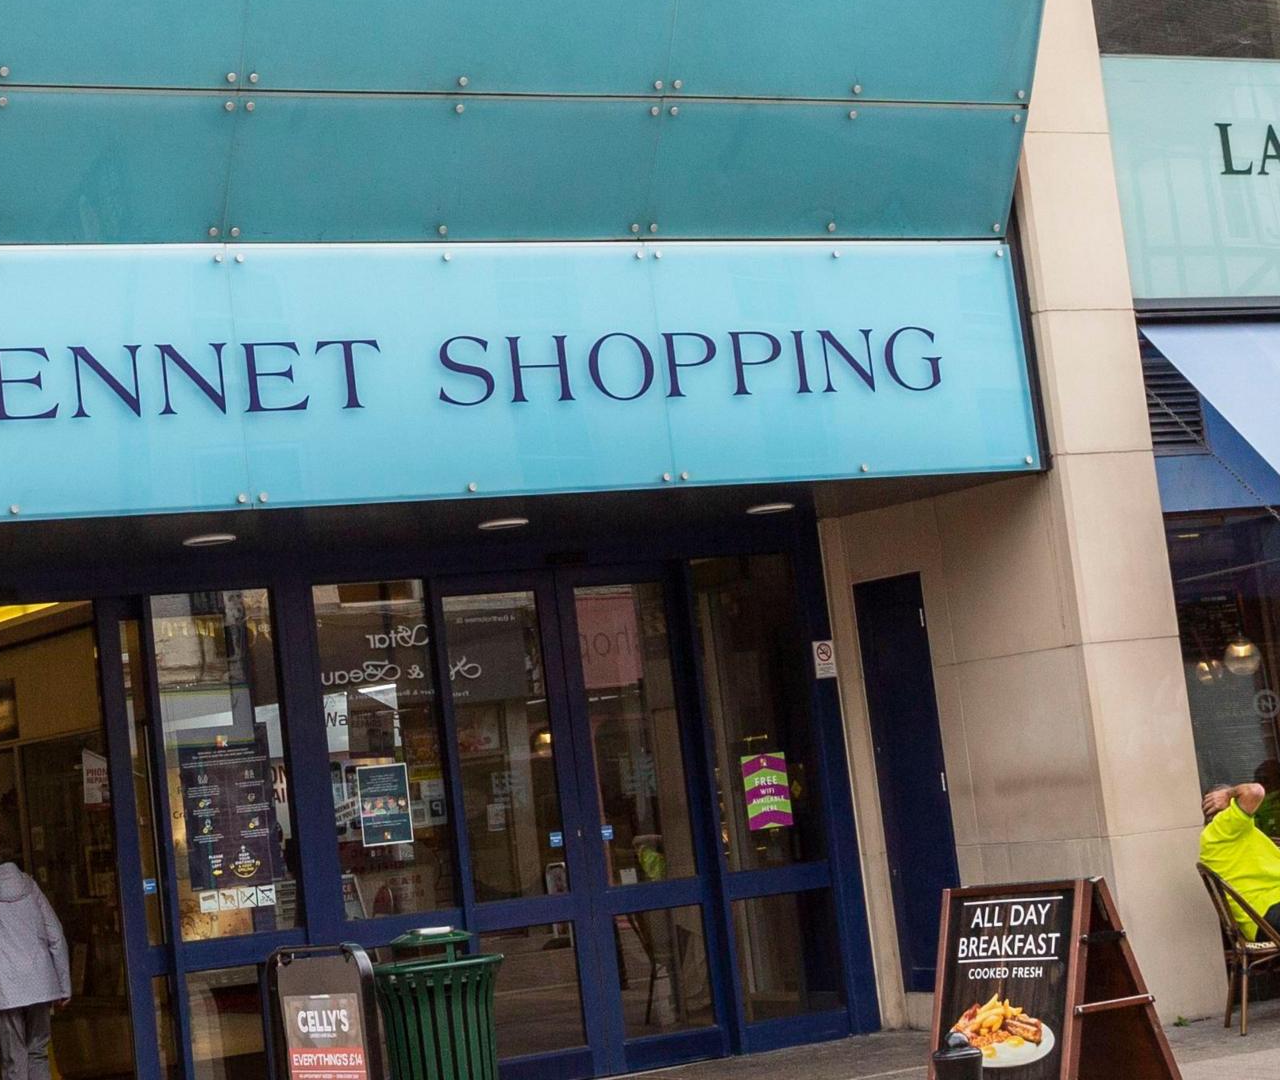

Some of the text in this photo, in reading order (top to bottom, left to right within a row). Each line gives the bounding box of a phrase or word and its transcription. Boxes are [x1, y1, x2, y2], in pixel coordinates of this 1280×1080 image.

[437, 324, 944, 407] SHOPPING
[754, 775, 778, 786] FREE
[971, 903, 1051, 929] ALL DAY
[958, 933, 1061, 958] BREAKFAST
[968, 966, 1043, 980] COOKED FRESH
[297, 1009, 349, 1033] CELLY'S
[292, 1052, 363, 1066] EVERYTHING'S £14
